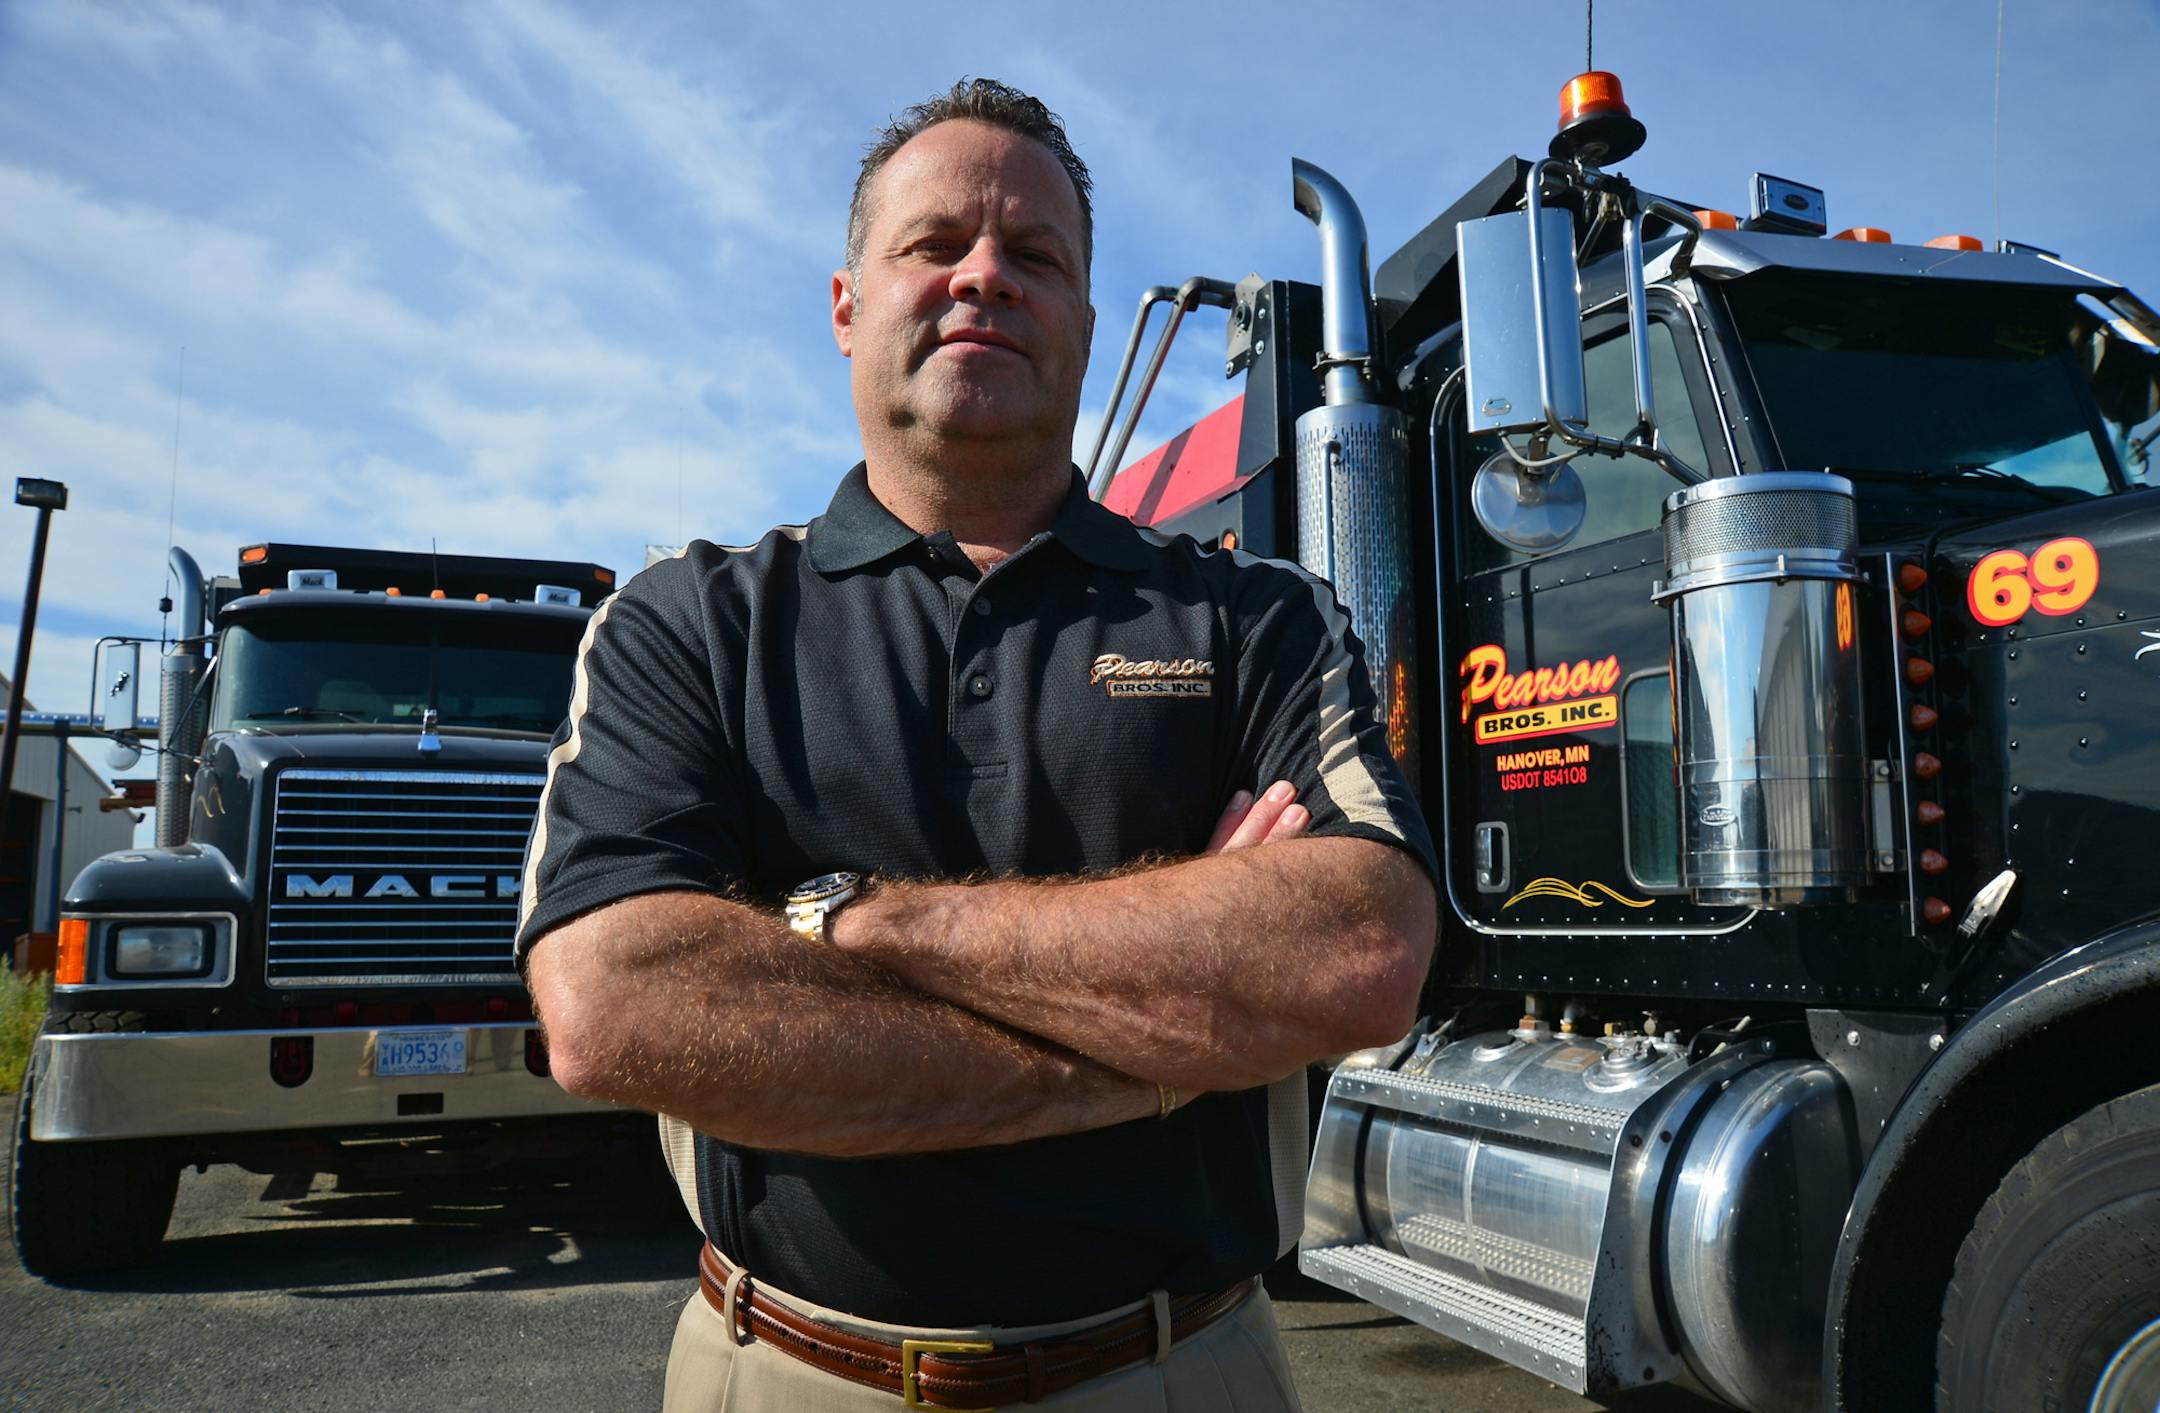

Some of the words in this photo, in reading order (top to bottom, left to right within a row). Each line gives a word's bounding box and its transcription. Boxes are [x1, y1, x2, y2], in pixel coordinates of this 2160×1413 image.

[1967, 536, 2099, 627] 69
[1090, 653, 1215, 685] Pearson
[1460, 644, 1621, 724] Pearson
[1484, 711, 1552, 734] BROS.
[1561, 702, 1610, 722] INC.
[1501, 770, 1540, 791] USDOT
[1543, 766, 1588, 787] 854108
